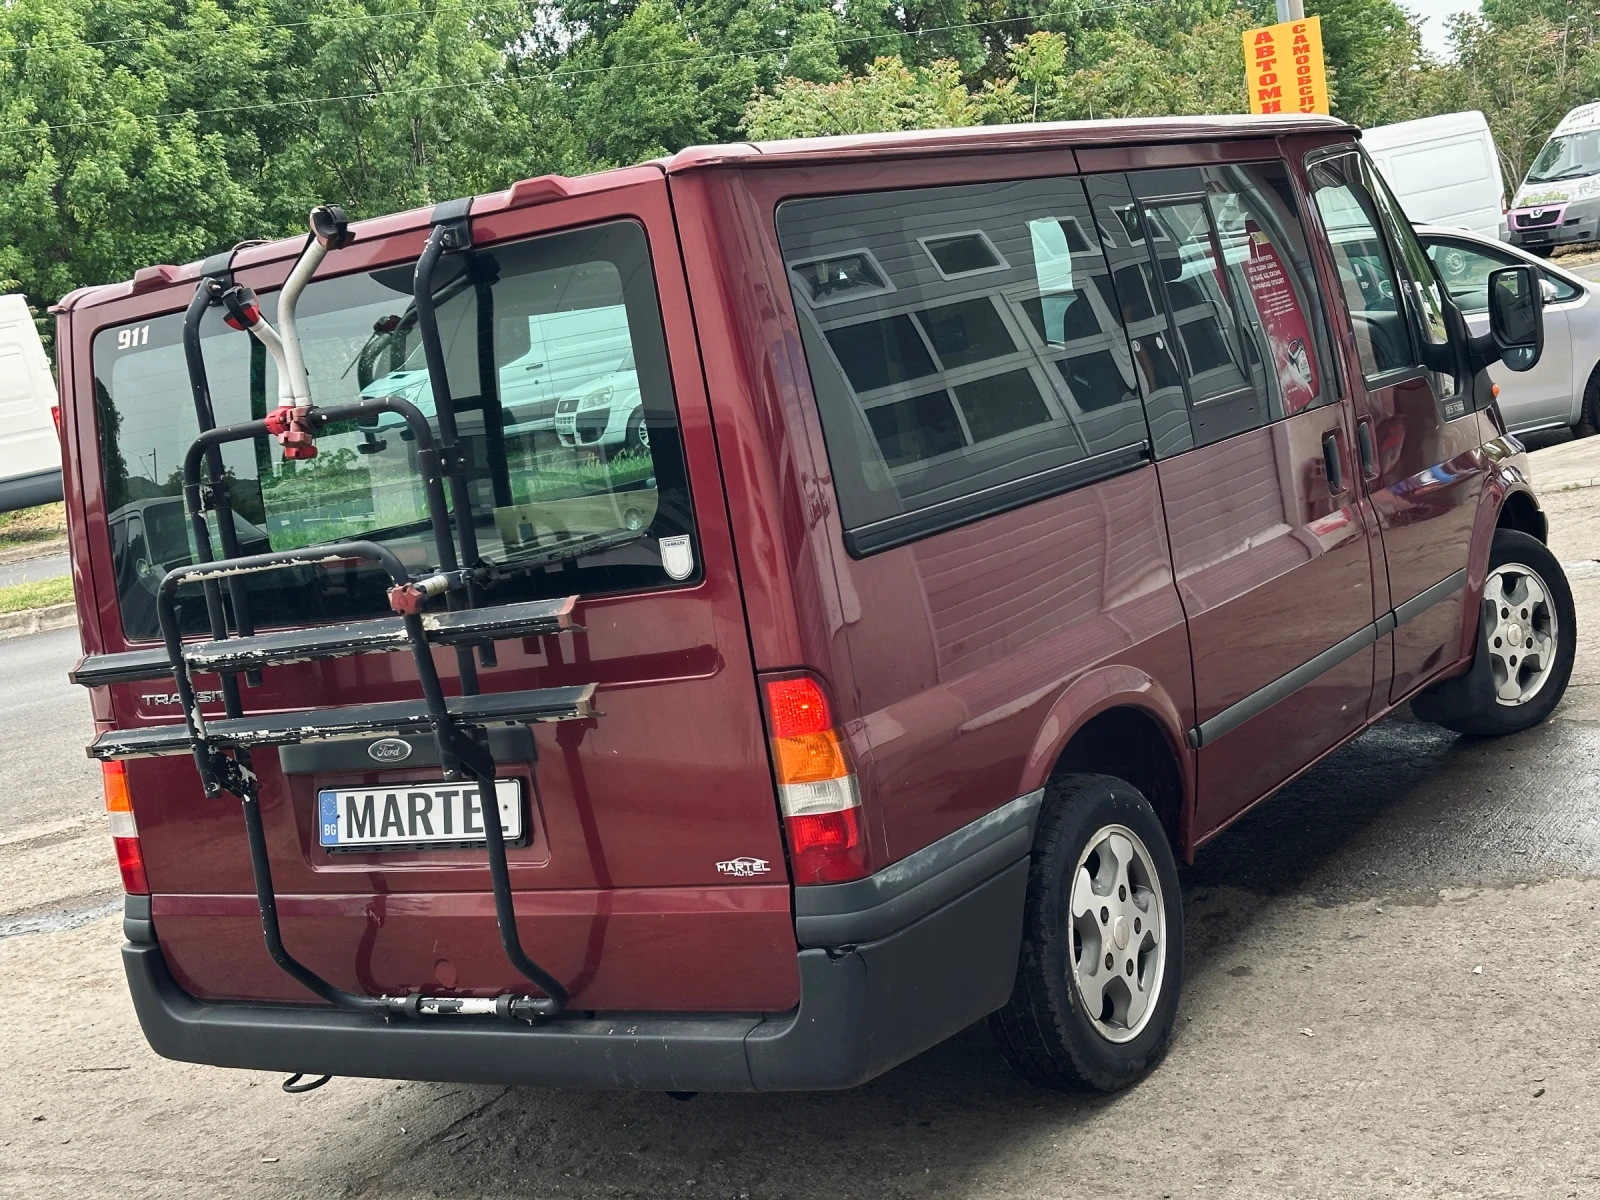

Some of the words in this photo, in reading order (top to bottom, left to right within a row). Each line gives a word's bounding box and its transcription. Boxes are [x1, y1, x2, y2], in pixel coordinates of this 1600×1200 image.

[117, 325, 149, 350] 911
[142, 690, 224, 706] TRASIT
[377, 744, 400, 757] Ford
[324, 823, 337, 836] BG
[717, 861, 771, 872] MARTEL
